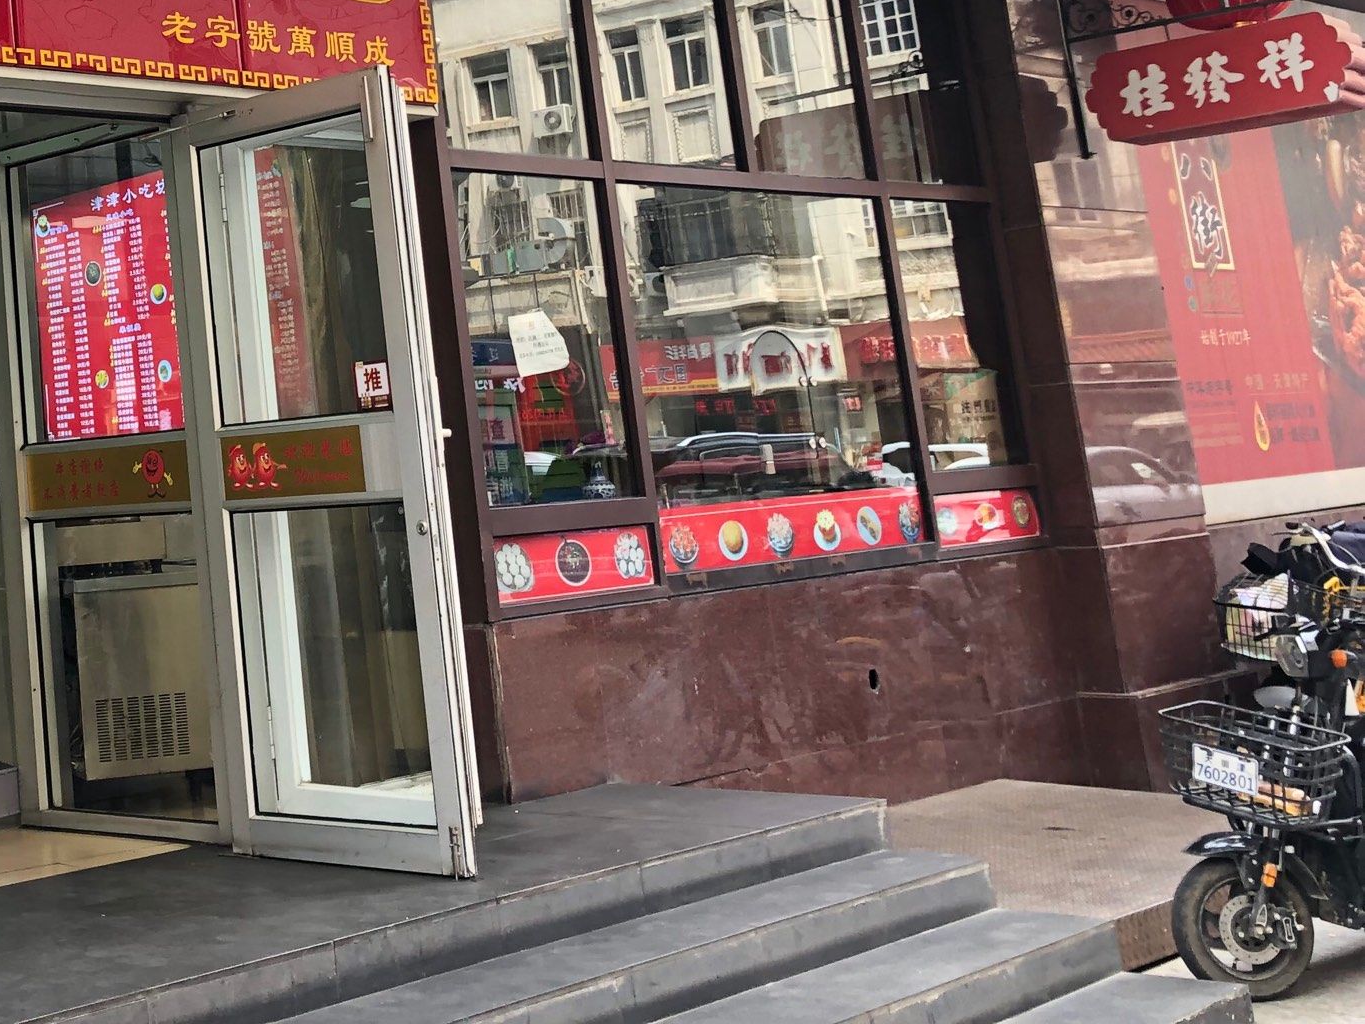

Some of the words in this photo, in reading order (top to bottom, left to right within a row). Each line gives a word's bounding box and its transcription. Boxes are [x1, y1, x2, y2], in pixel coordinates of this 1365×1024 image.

[161, 11, 396, 68] 老字號萬順成
[1119, 31, 1315, 118] 桂發祥
[363, 367, 383, 392] 推
[1196, 762, 1254, 792] 7602801
